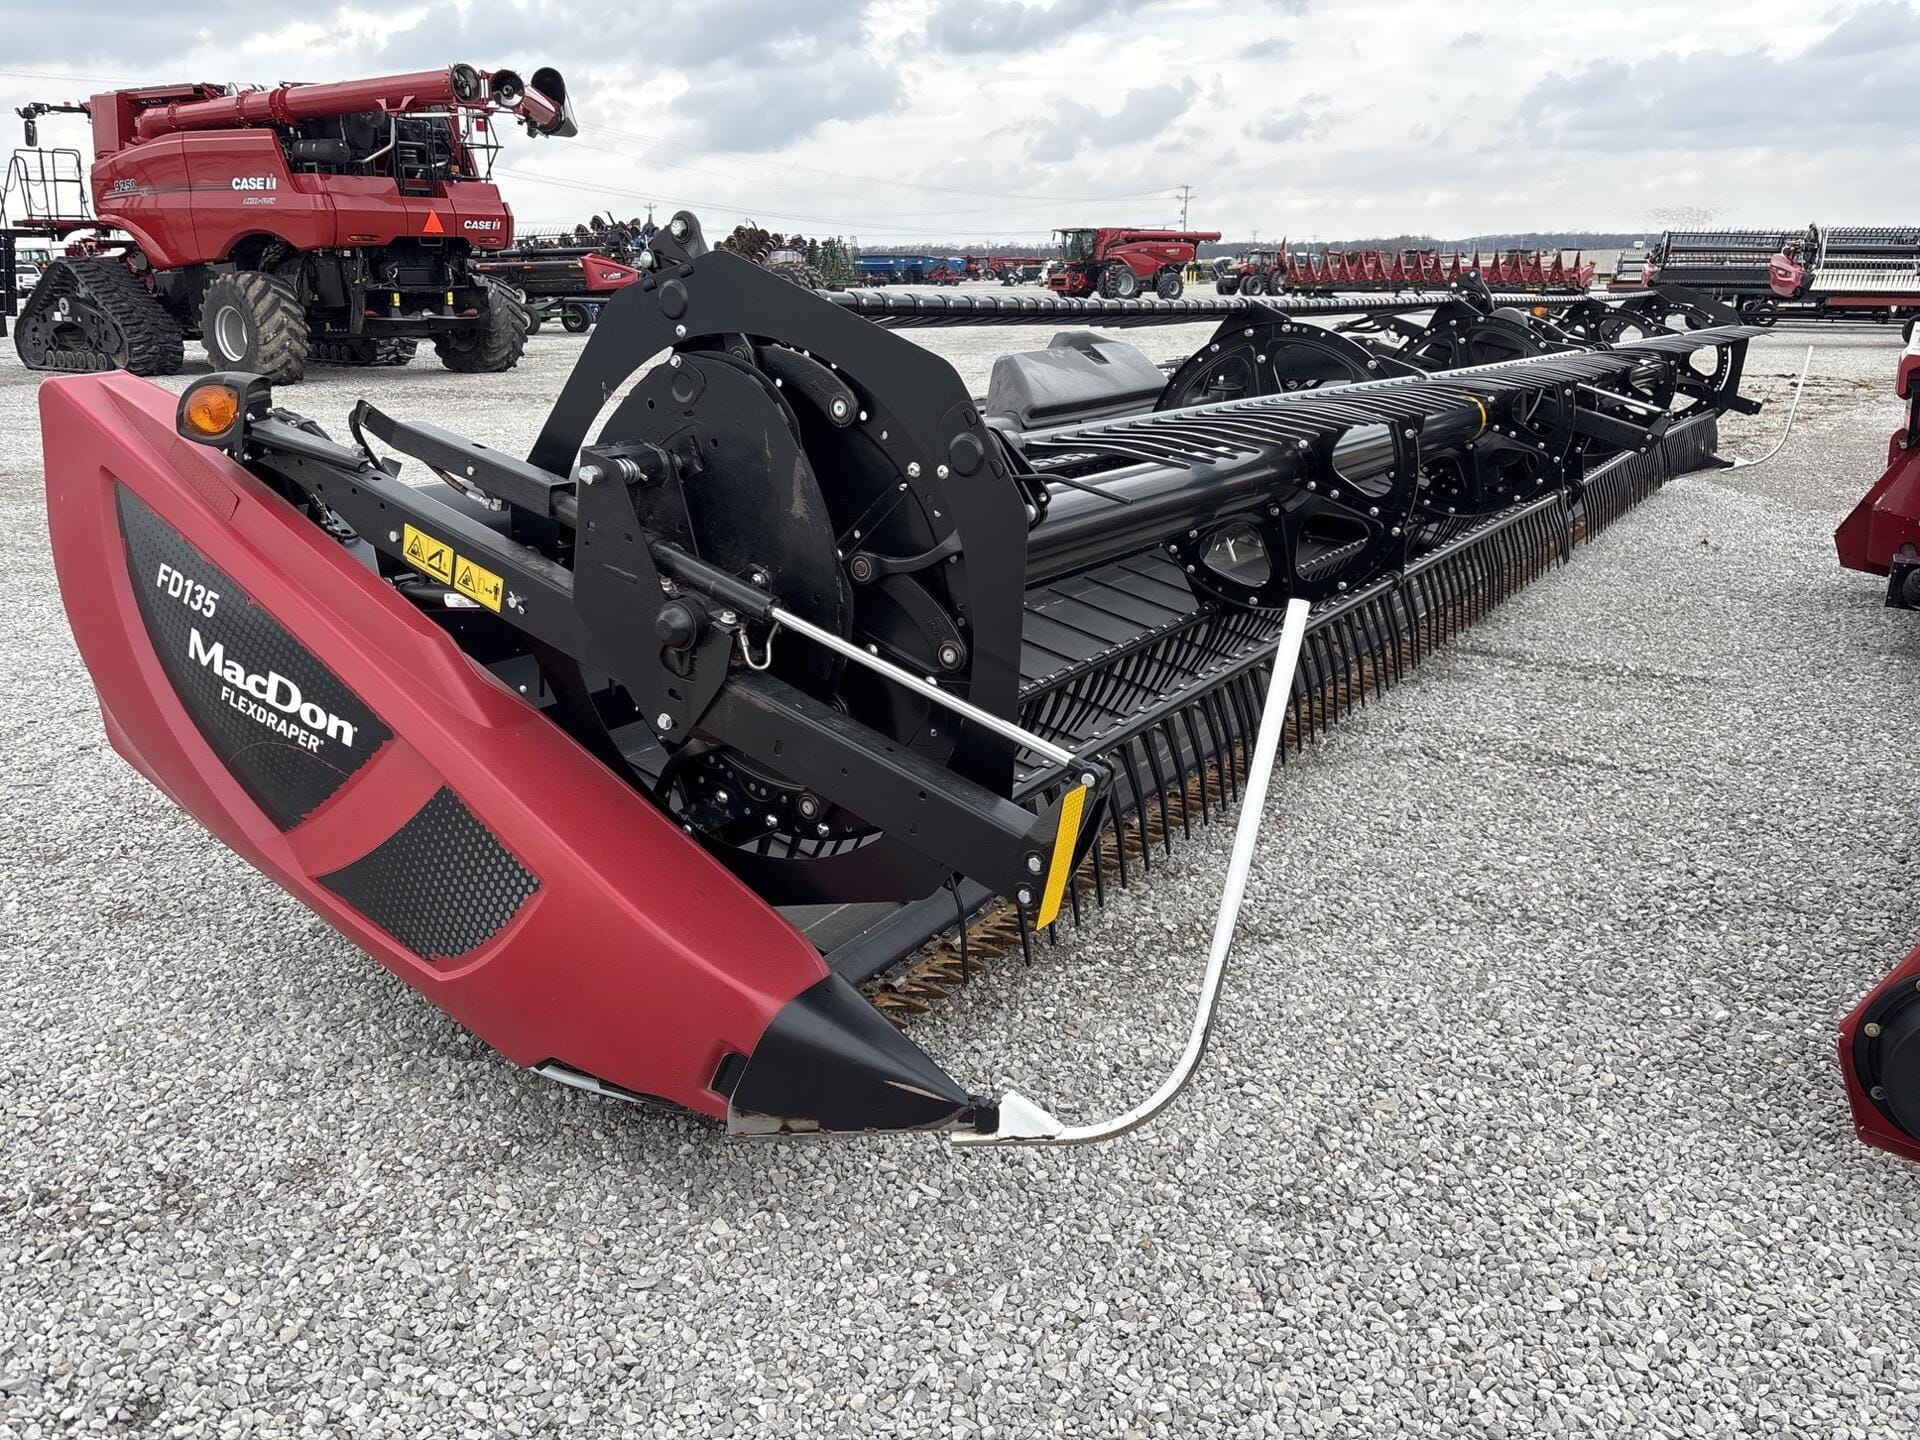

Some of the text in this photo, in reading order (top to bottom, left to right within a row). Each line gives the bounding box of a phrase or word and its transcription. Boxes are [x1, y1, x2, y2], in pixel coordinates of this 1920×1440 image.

[231, 177, 264, 190] CASE
[464, 220, 491, 230] CASE
[156, 562, 220, 618] FD135
[188, 627, 356, 747] MacDon
[221, 686, 323, 753] FLEXDRAPER
